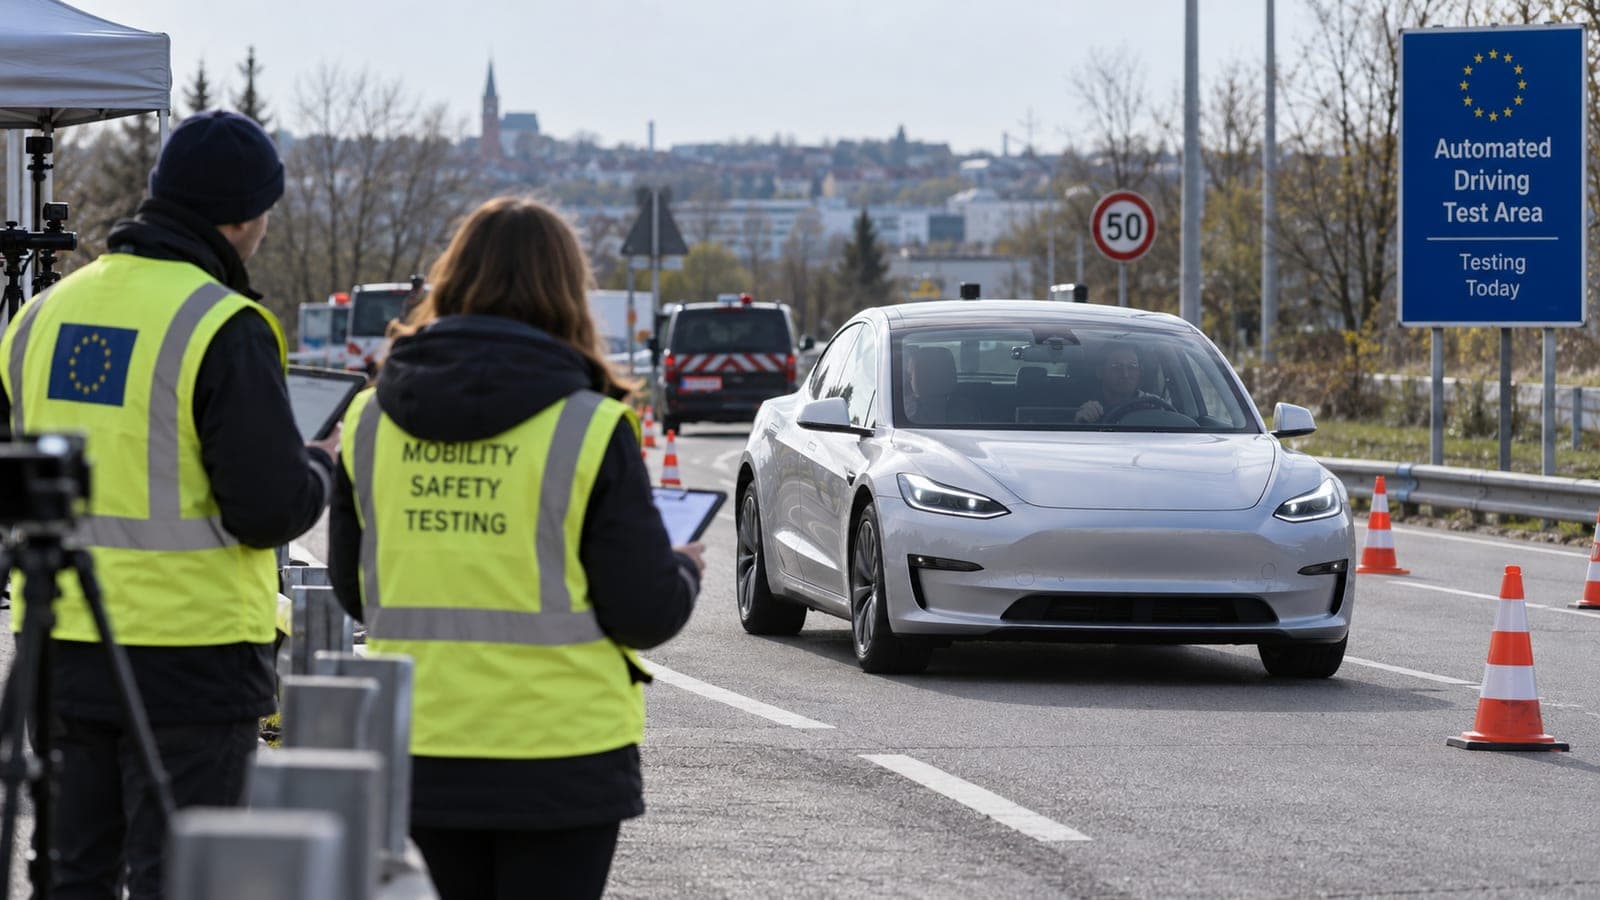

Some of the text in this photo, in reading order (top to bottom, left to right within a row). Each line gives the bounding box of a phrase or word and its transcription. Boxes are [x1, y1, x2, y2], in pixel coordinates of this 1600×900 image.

[1434, 136, 1552, 160] Automated
[1454, 169, 1530, 196] Driving
[1443, 202, 1543, 223] Test Area
[1107, 212, 1142, 241] 50
[1459, 253, 1527, 274] Testing
[1466, 279, 1520, 300] Today
[402, 441, 519, 466] MOBILITY
[410, 474, 503, 500] SAFETY
[404, 509, 507, 535] TESTING
